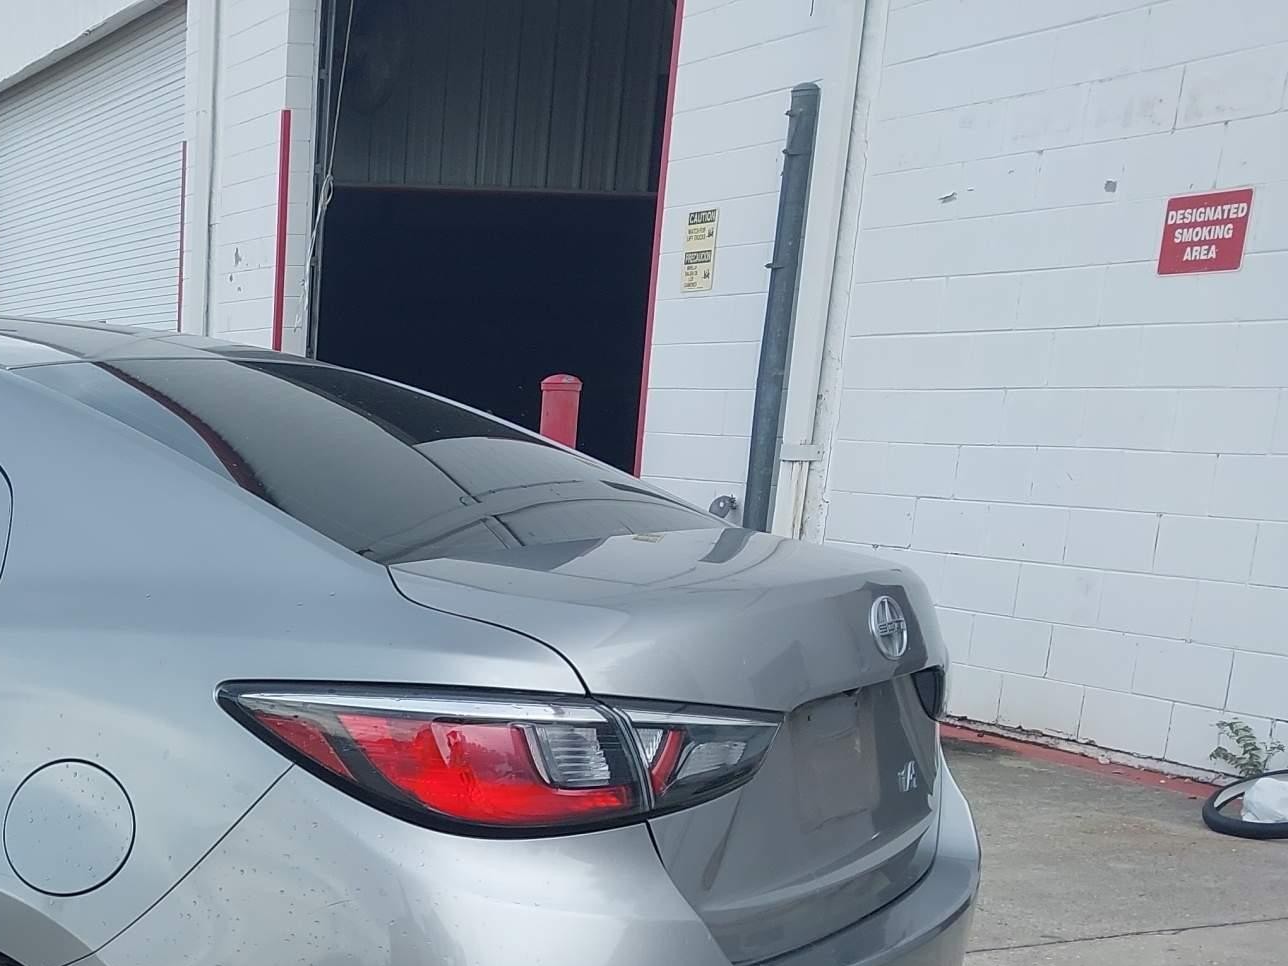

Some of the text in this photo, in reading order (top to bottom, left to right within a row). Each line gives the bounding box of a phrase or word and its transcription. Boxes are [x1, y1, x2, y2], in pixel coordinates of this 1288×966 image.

[689, 210, 716, 225] CAUTION
[1167, 203, 1248, 225] DESIGNATED
[1173, 223, 1234, 243] SMOKING
[1182, 244, 1217, 261] AREA
